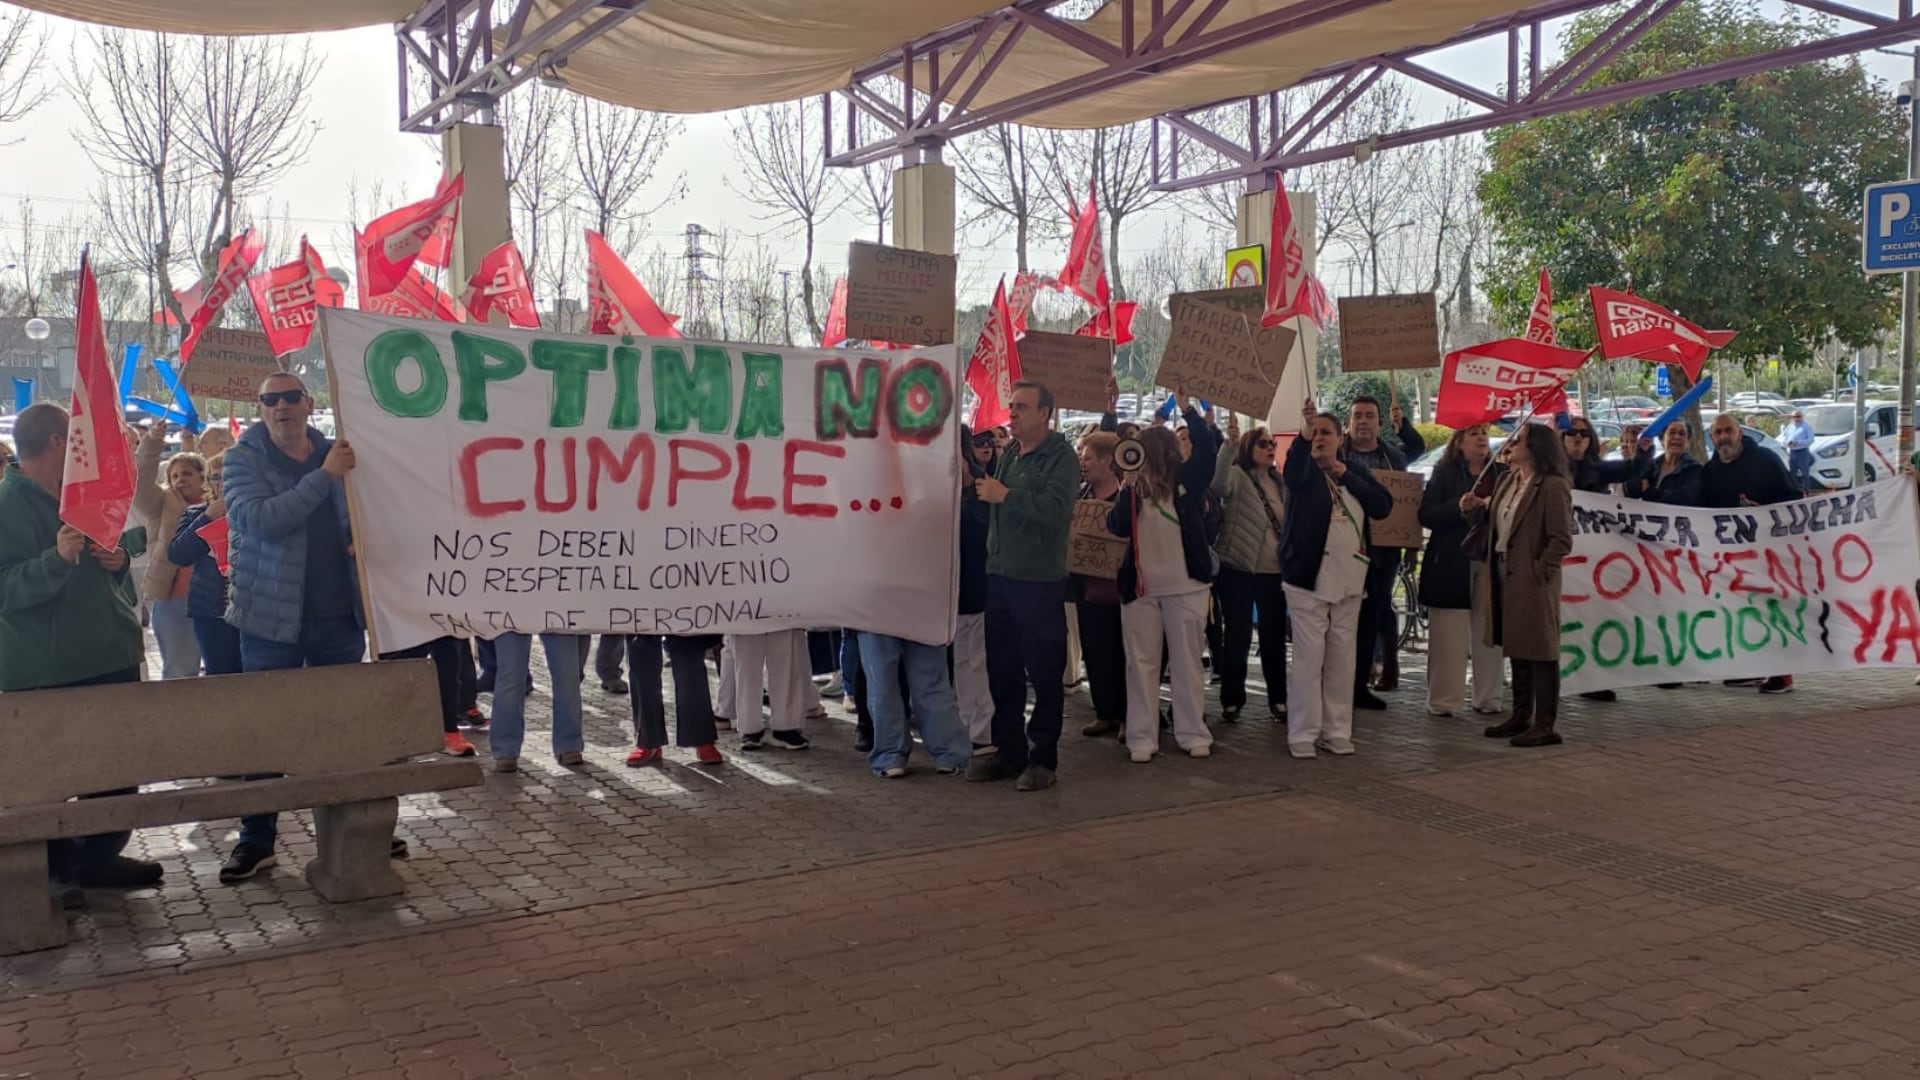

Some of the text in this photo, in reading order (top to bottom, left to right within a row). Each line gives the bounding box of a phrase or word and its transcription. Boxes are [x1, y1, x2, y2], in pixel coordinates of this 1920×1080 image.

[1880, 192, 1910, 237] P
[875, 249, 940, 272] OPTIMA
[904, 314, 925, 327] NO
[228, 376, 250, 388] NO
[1169, 344, 1238, 382] SUELDO
[364, 328, 784, 441] OPTIMA
[814, 358, 953, 446] NO
[1713, 514, 1758, 544] EN
[1769, 490, 1877, 537] LUCHA
[433, 521, 778, 561] NOS DEBEN DINERO
[427, 553, 790, 597] NO RESPETA EL CONVENIO
[545, 609, 585, 631] DE
